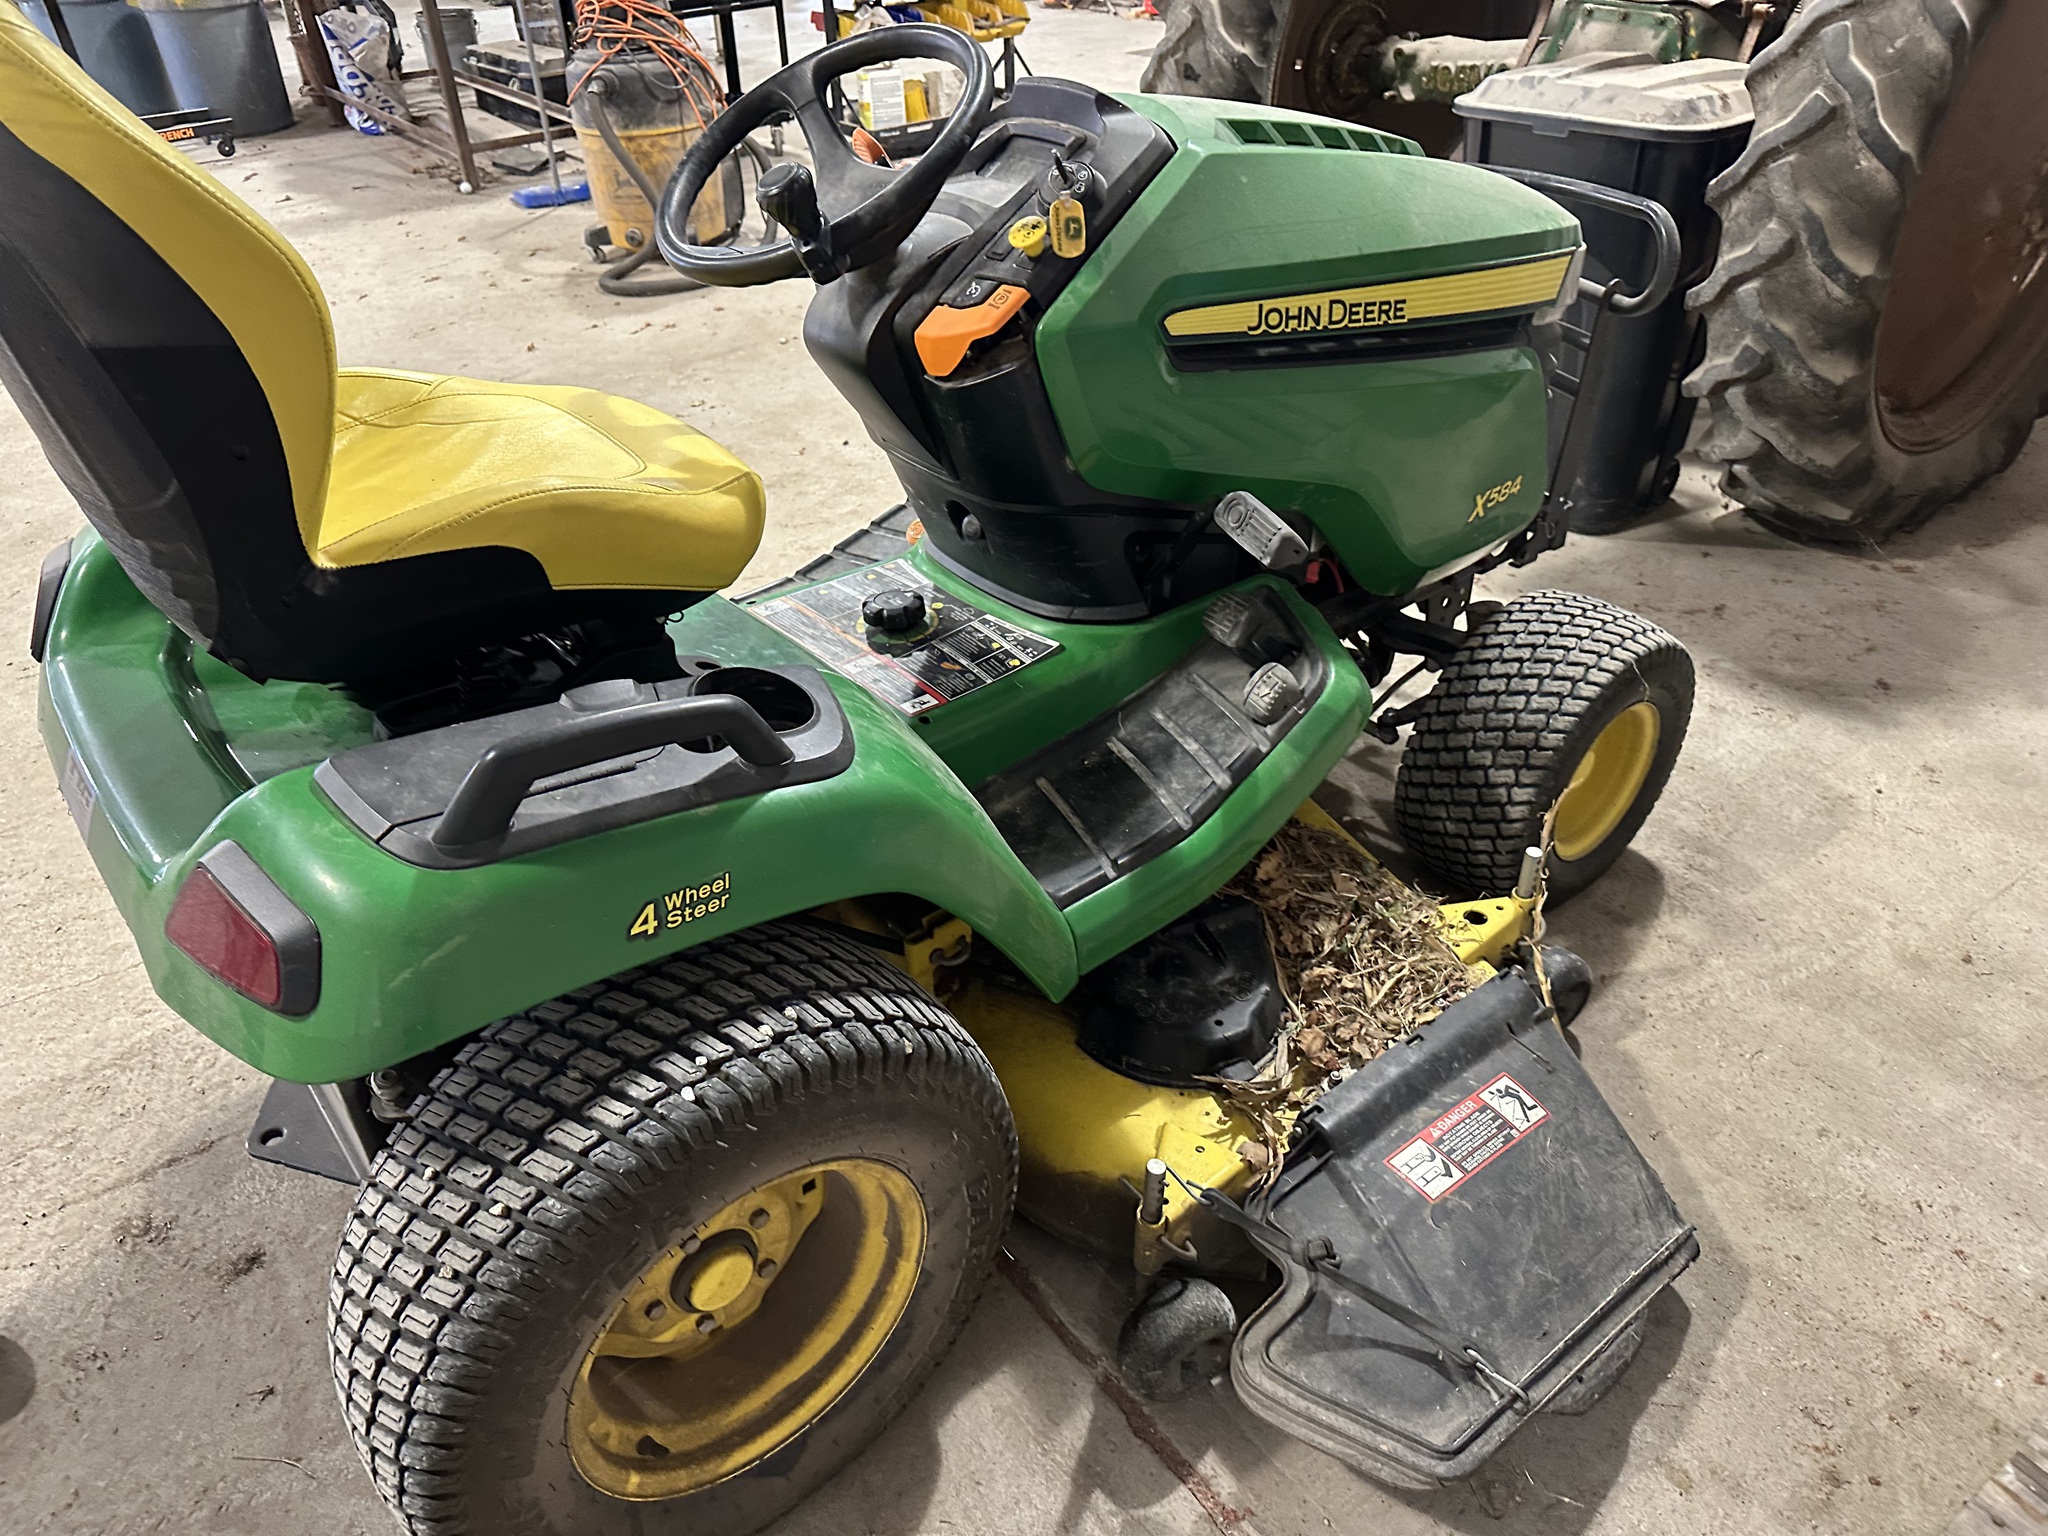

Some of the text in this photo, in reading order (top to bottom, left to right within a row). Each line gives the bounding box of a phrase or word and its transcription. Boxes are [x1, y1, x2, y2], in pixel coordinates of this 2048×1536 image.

[1247, 299, 1407, 332] JOHN DEERE
[1467, 474, 1524, 523] X584
[629, 872, 731, 936] 4 Wheel
[666, 893, 731, 928] Steer
[1436, 1100, 1478, 1131] DANGER
